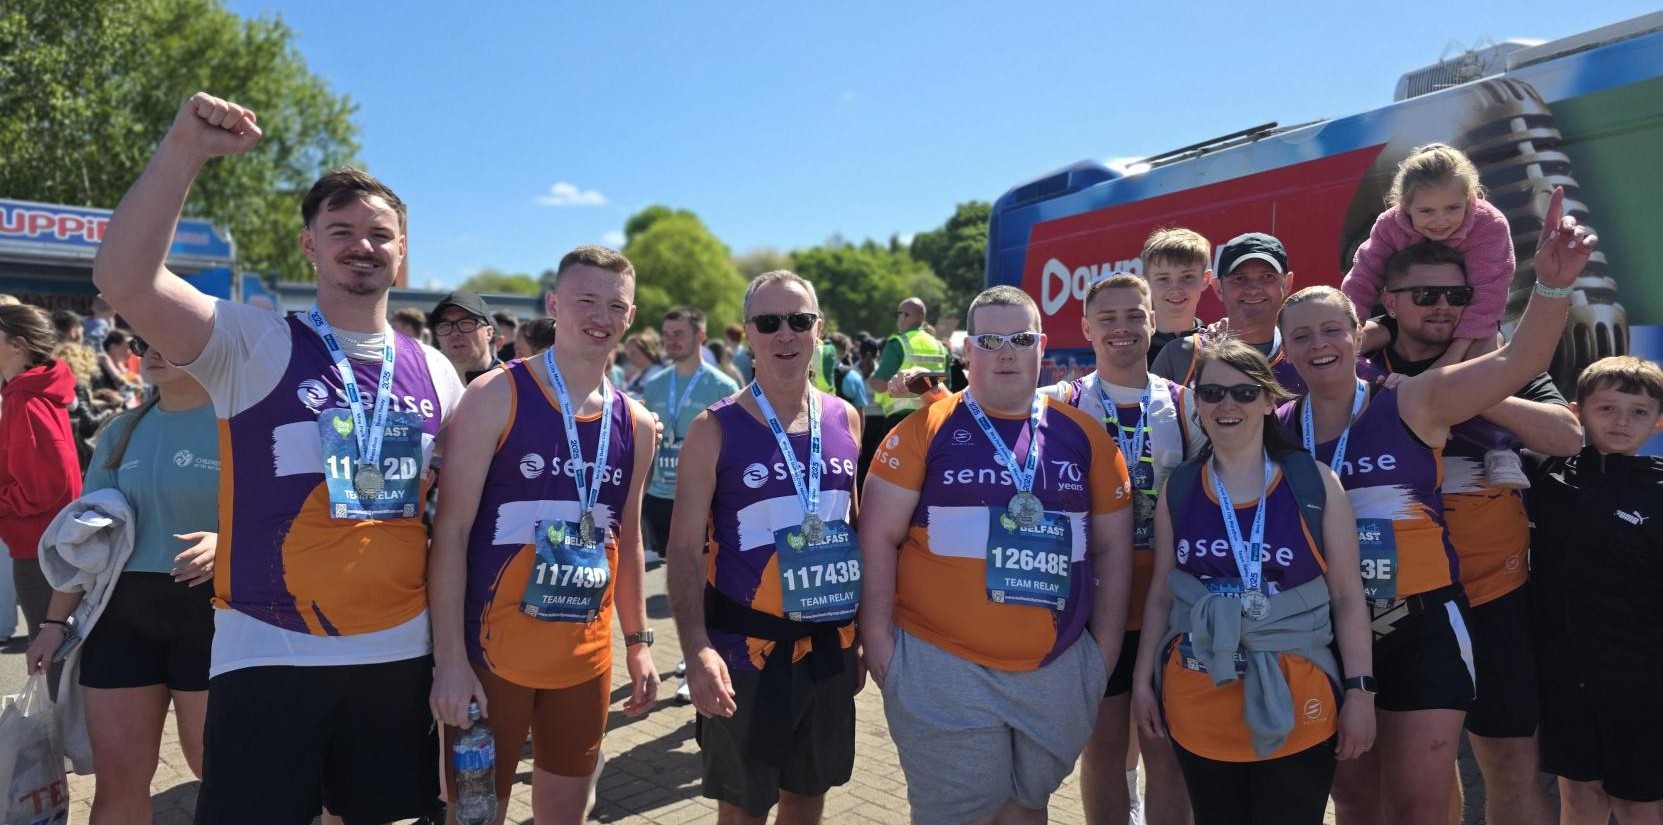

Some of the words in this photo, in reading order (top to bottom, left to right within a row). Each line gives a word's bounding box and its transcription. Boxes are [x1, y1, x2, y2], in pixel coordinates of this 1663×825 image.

[310, 310, 324, 328] 2025
[381, 371, 391, 389] 2025
[968, 401, 981, 416] 2025
[568, 439, 582, 460] 2025
[327, 455, 418, 480] 112D
[552, 456, 623, 486] sense
[811, 462, 819, 479] 2025
[1051, 460, 1082, 482] 70
[1341, 454, 1397, 475] nse
[943, 468, 1013, 486] sens
[374, 489, 405, 500] ELAY
[1058, 482, 1084, 491] years
[808, 533, 849, 546] LFAST
[991, 547, 1069, 577] 12648E
[536, 562, 607, 589] 11743D
[783, 559, 861, 591] 11743B
[1004, 578, 1032, 588] TEAM
[1033, 581, 1060, 593] RELAY
[542, 594, 566, 605] TEAM
[566, 596, 592, 606] RELAY
[800, 595, 828, 607] TEAM
[829, 591, 855, 603] RELAY
